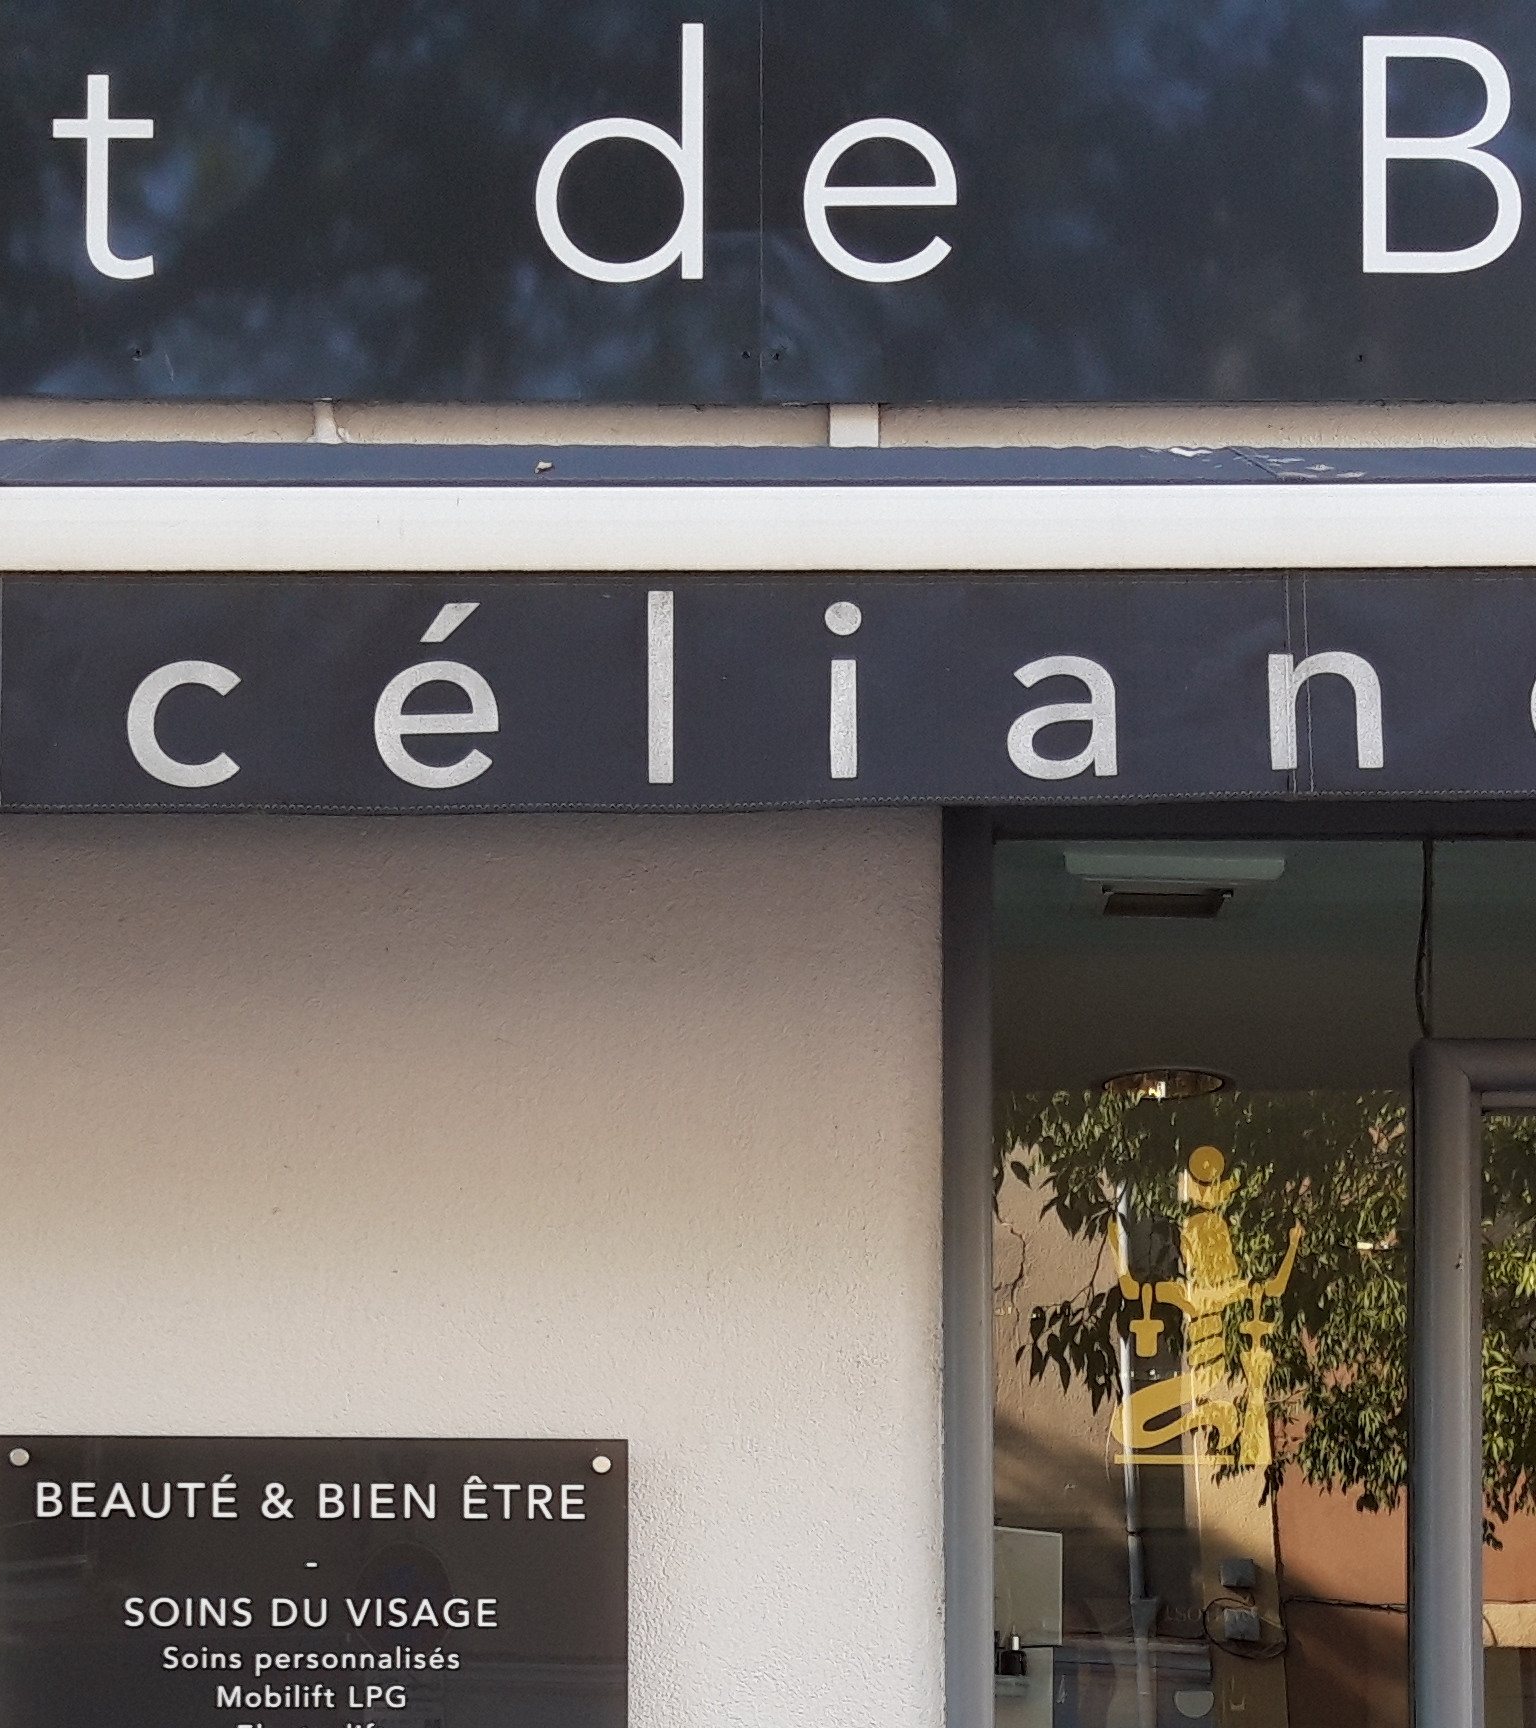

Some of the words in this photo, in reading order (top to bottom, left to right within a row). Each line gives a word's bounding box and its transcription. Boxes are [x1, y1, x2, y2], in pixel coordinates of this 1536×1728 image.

[536, 24, 957, 282] de
[37, 1474, 237, 1518] BEAUTÉ
[262, 1483, 293, 1518] &
[319, 1484, 435, 1518] BIEN
[464, 1476, 585, 1519] ÊTRE
[125, 1598, 252, 1626] SOINS
[272, 1598, 327, 1627] DU
[346, 1598, 497, 1627] VISAGE
[163, 1647, 241, 1669] Soins
[256, 1646, 459, 1676] personnalisés
[217, 1685, 334, 1707] Mobilift
[350, 1686, 405, 1707] LPG
